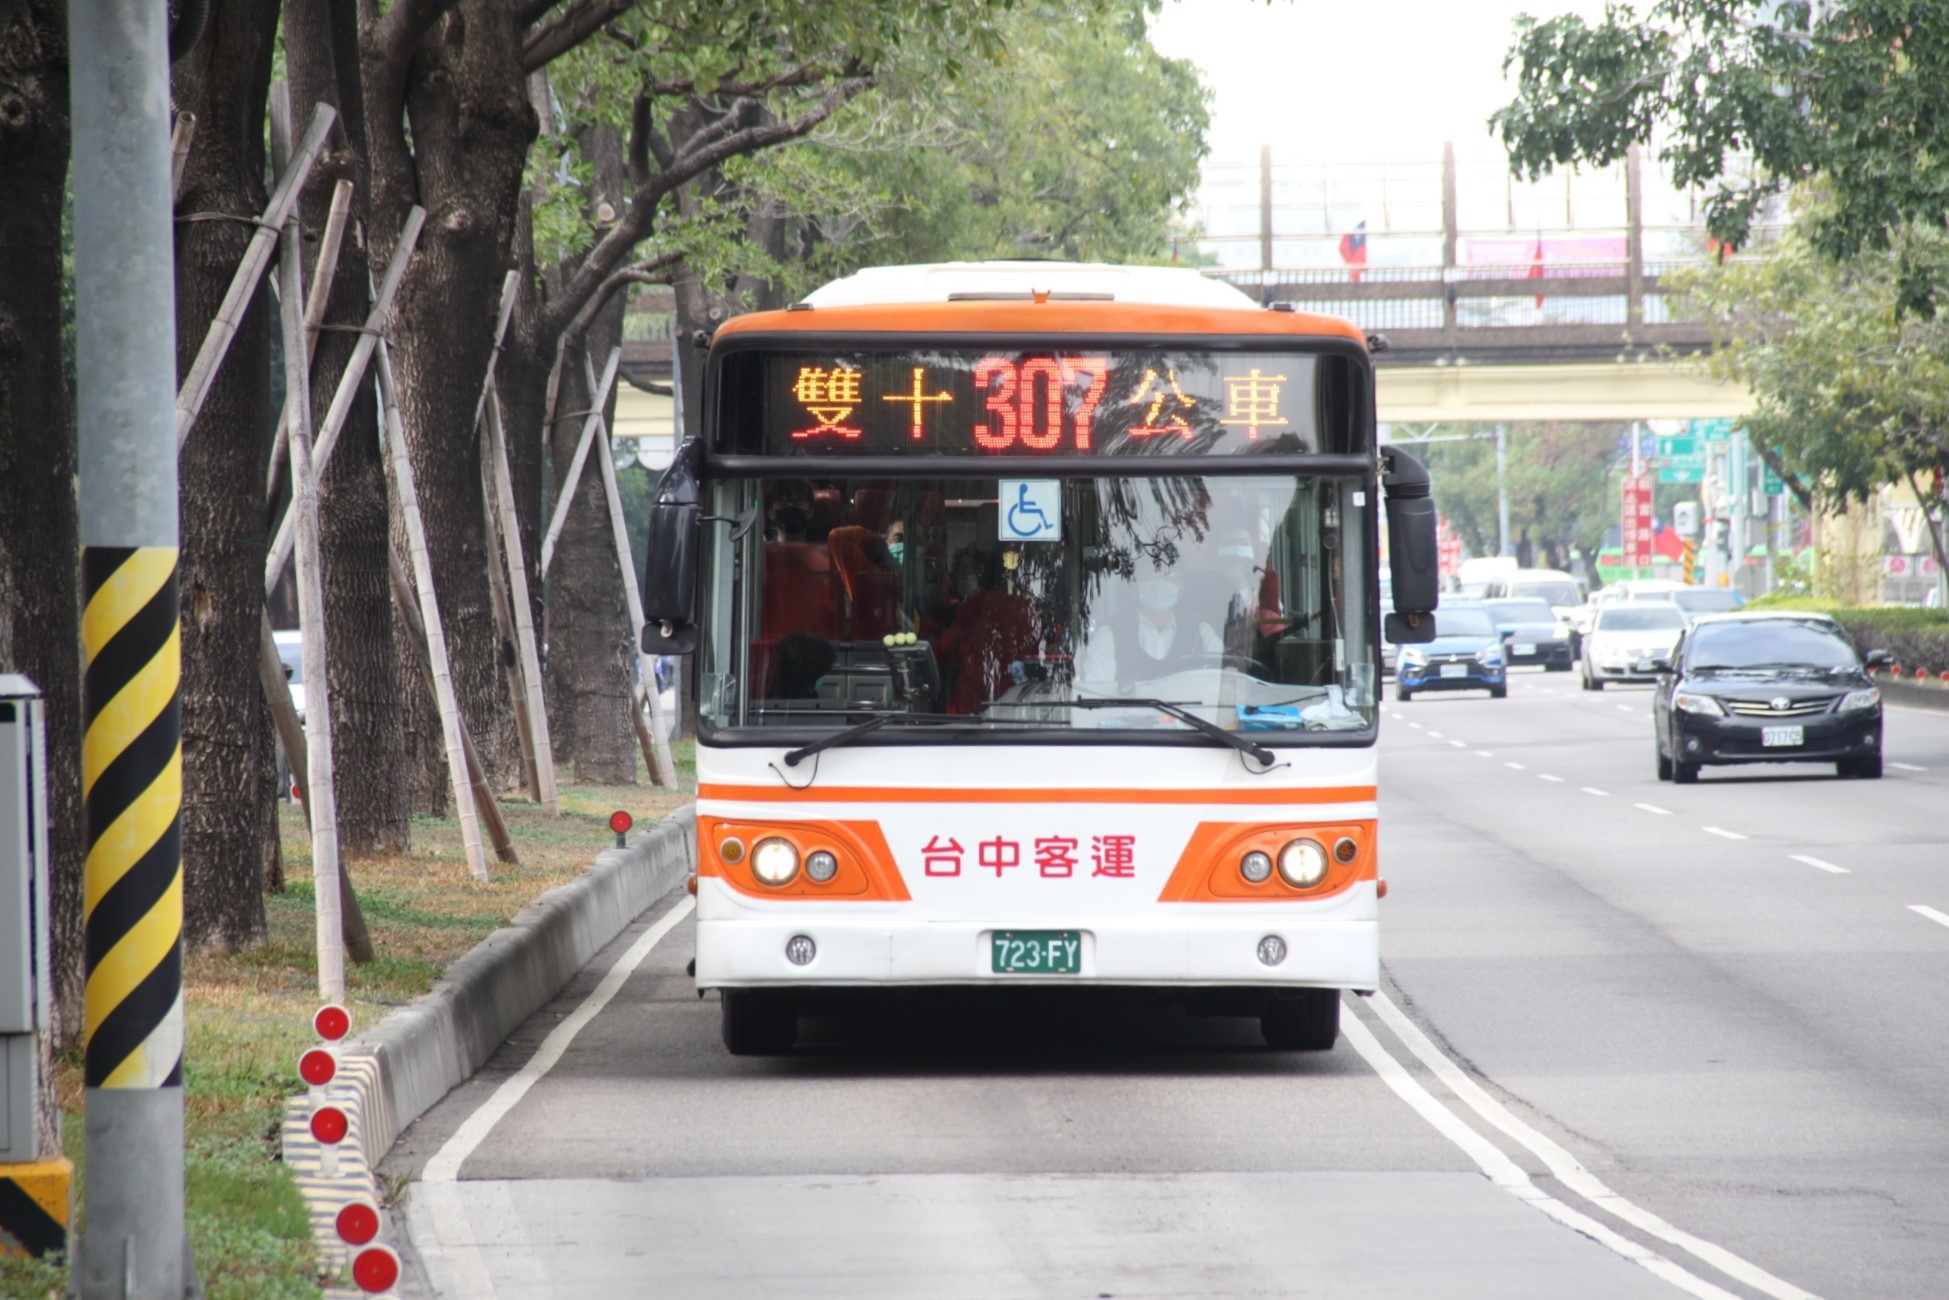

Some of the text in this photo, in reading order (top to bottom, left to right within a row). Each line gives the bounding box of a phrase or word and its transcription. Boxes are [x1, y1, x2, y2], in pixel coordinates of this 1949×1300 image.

[920, 834, 1136, 879] 台中客運
[995, 939, 1079, 968] 723-FY
